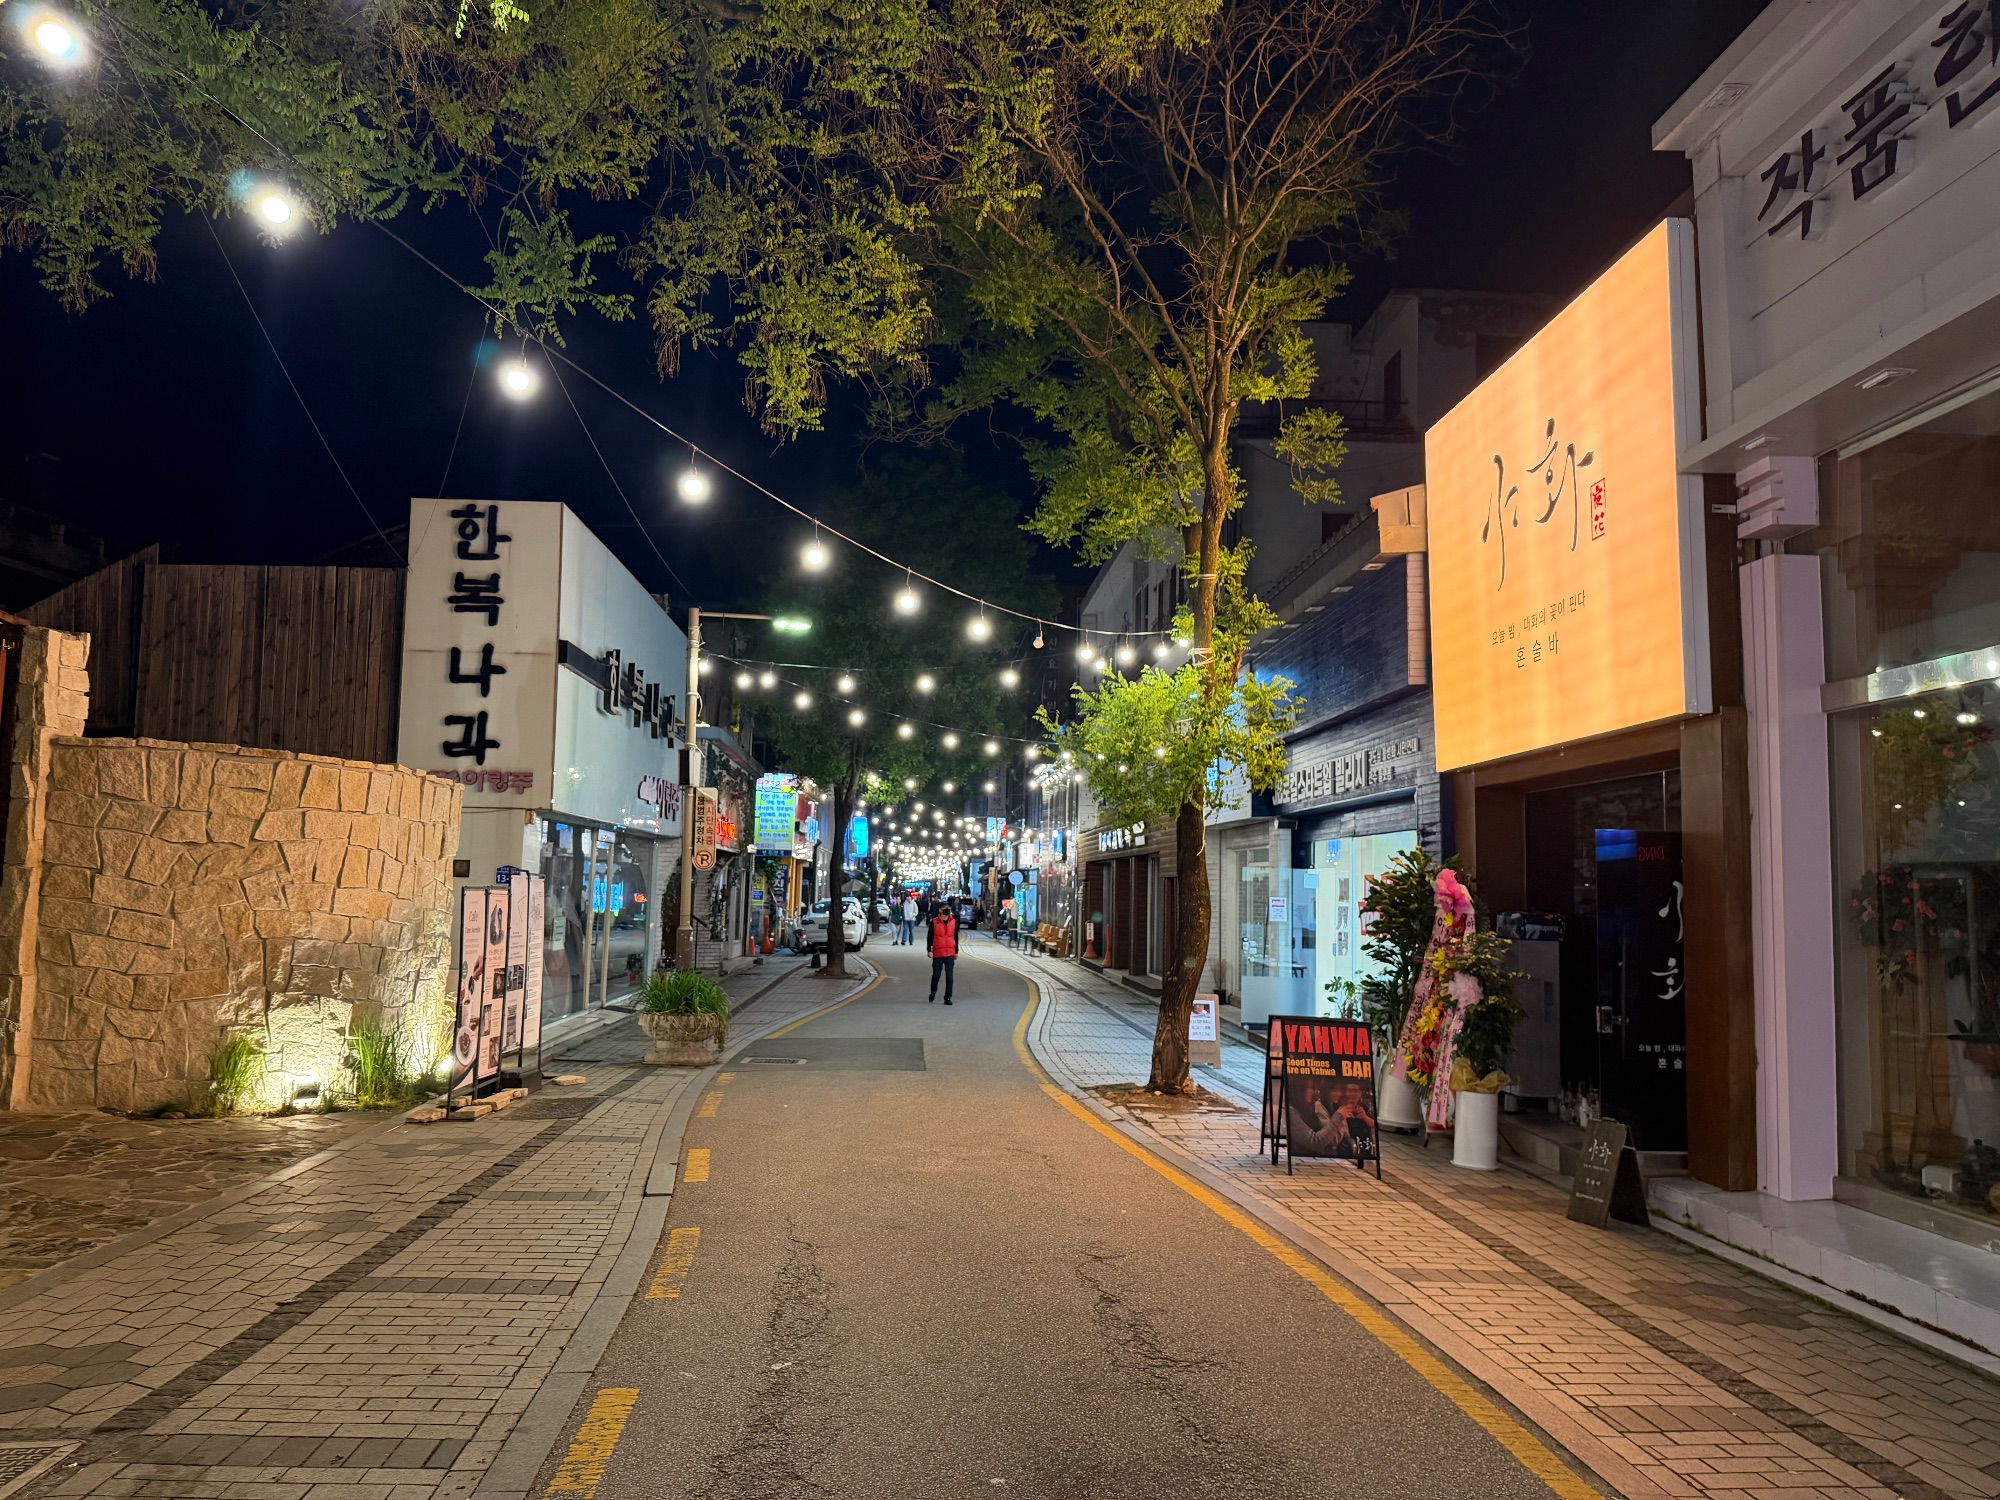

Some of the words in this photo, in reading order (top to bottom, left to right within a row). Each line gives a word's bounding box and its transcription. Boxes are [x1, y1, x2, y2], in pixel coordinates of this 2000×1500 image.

[442, 503, 512, 766] 한복나라
[1491, 628, 1506, 646] 오늘
[1523, 607, 1546, 632] 대화의
[1549, 598, 1566, 622] 꽃이
[1569, 589, 1586, 613] 핀다
[1335, 751, 1367, 793] 빌리지
[695, 796, 706, 846] 불법주정차
[1284, 1024, 1371, 1056] YAHWA
[1286, 1057, 1305, 1067] Good
[1306, 1058, 1331, 1068] Times
[1287, 1066, 1300, 1074] Are
[1300, 1067, 1310, 1075] on
[1310, 1066, 1336, 1076] Yahwa
[1341, 1060, 1372, 1078] BAR
